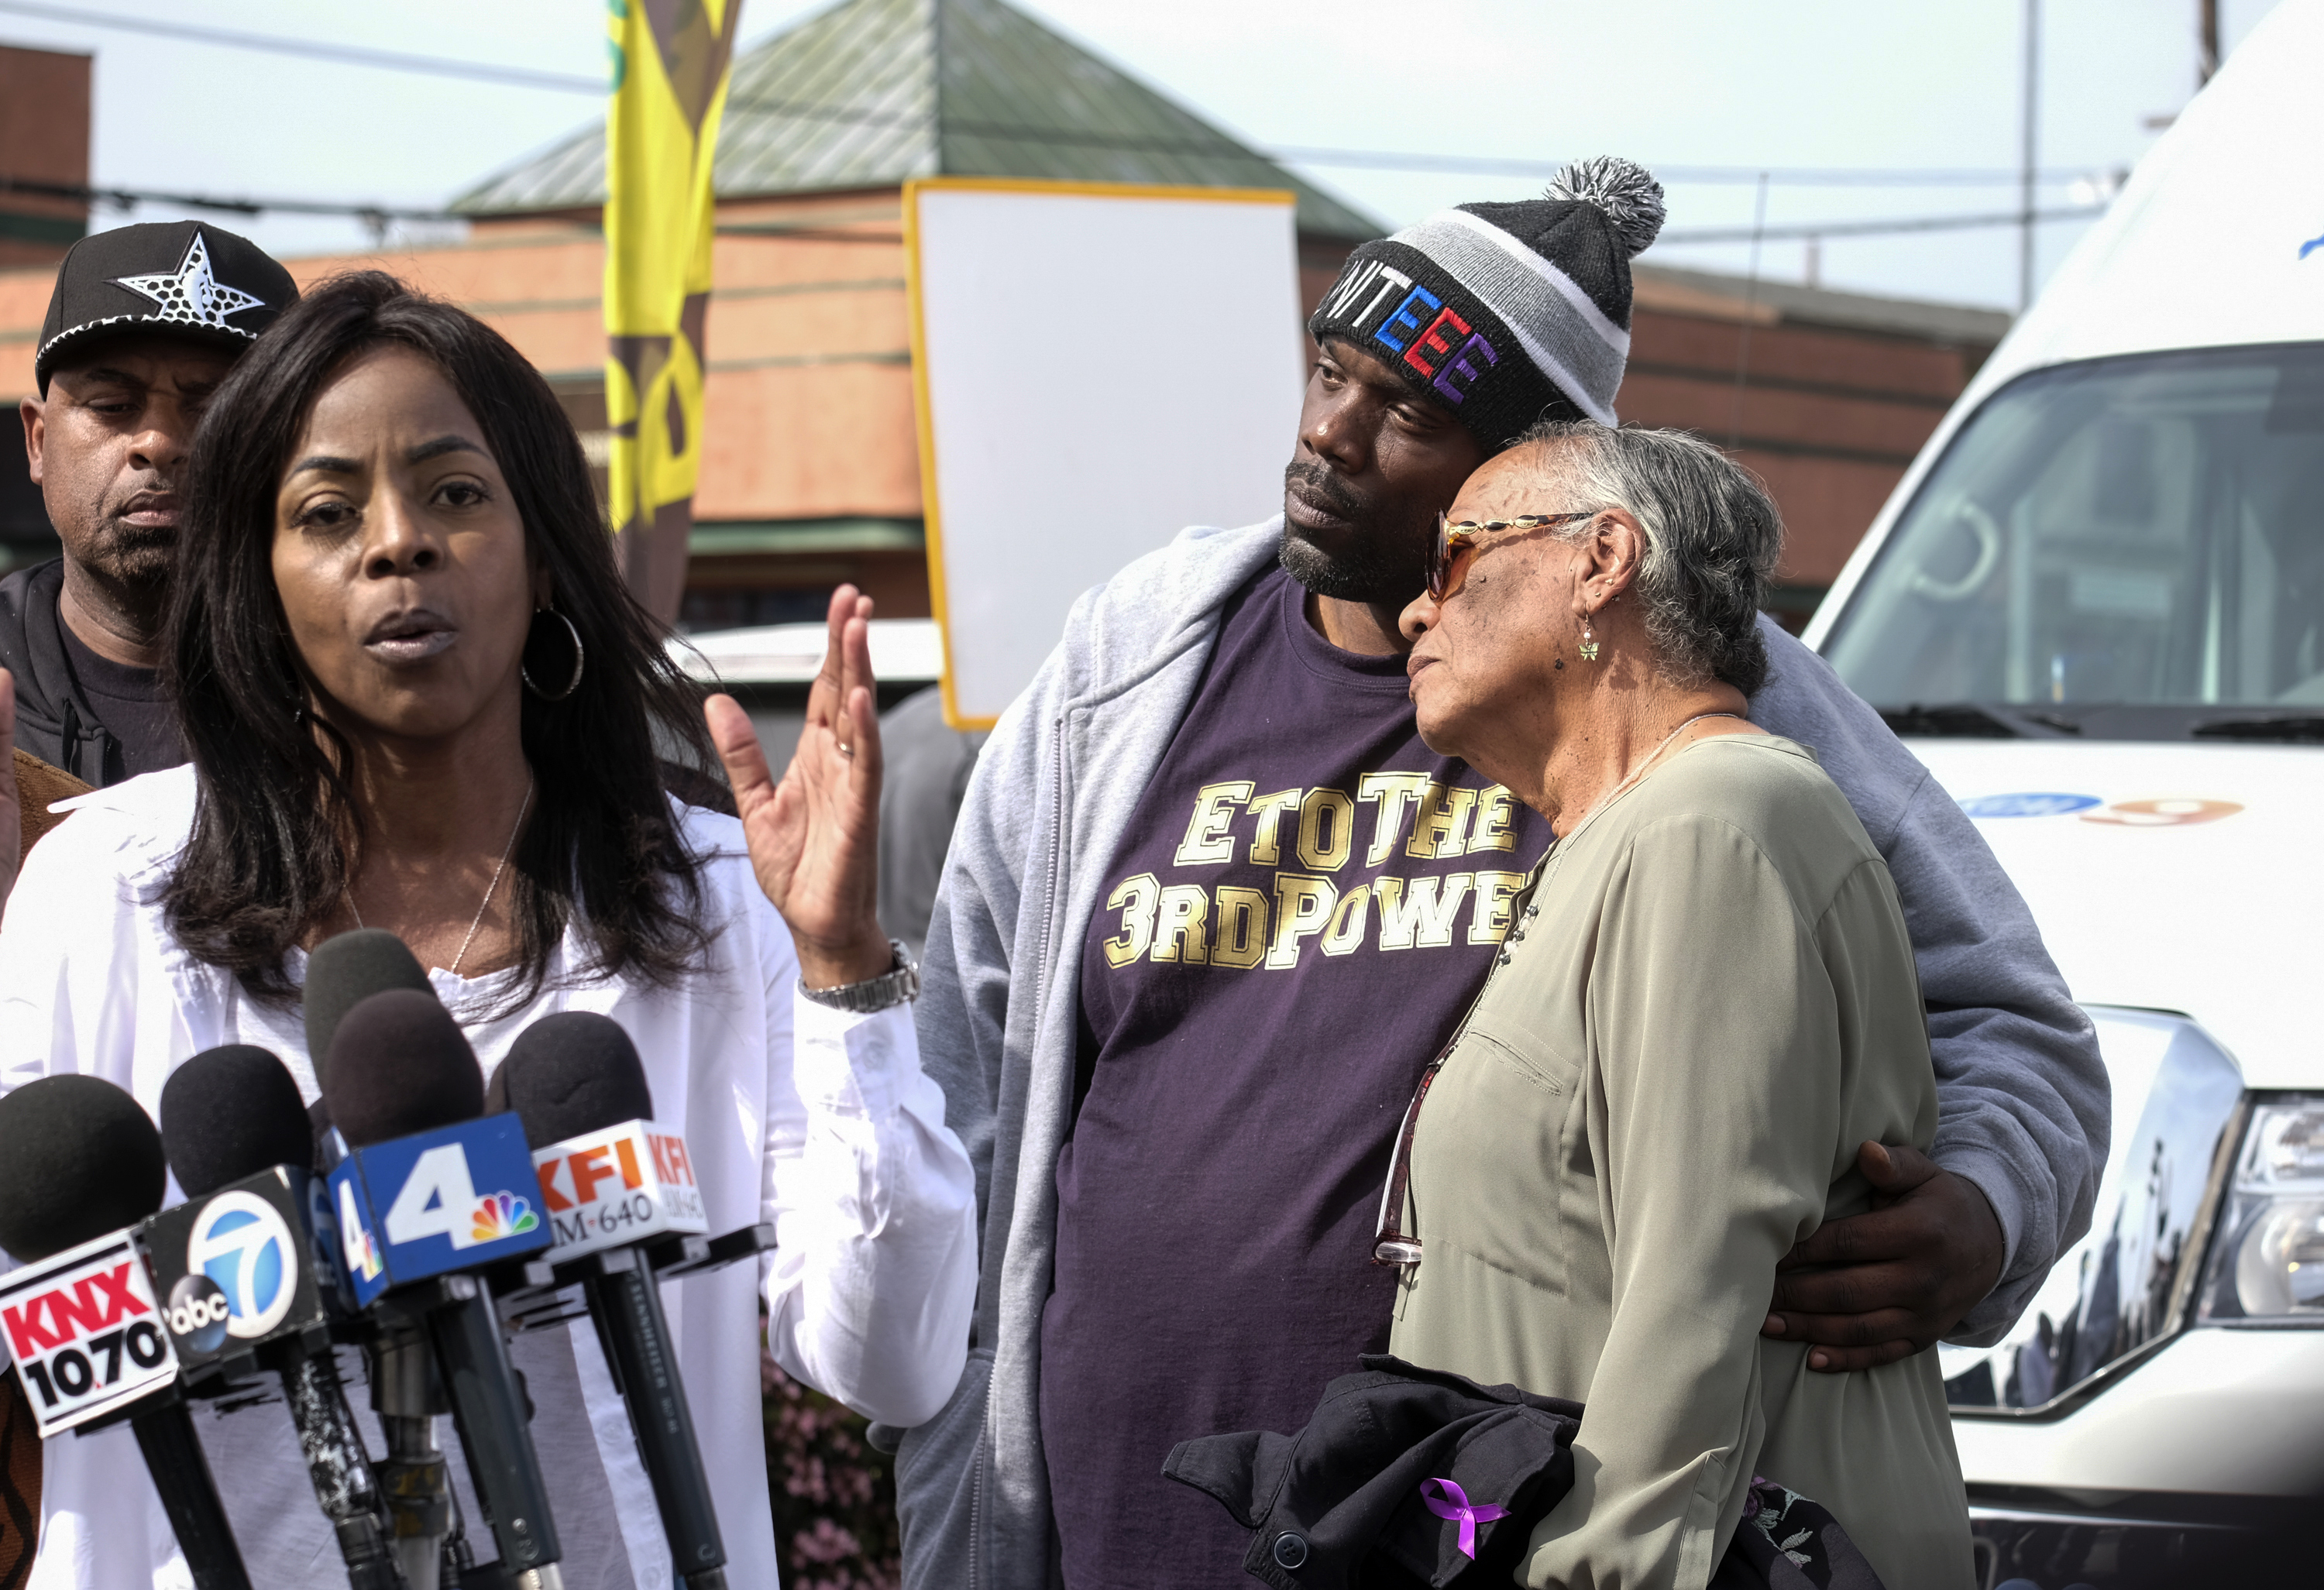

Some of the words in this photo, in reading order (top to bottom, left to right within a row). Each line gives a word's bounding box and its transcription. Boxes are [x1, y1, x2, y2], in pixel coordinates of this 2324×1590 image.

[1315, 259, 1499, 404] NITEEE
[385, 1142, 486, 1250] 4
[648, 1134, 694, 1186] KFI
[339, 1179, 373, 1283] 4
[597, 1193, 653, 1234] 640
[2, 1261, 152, 1360] KNX
[170, 1292, 230, 1335] abc
[197, 1207, 287, 1329] 7
